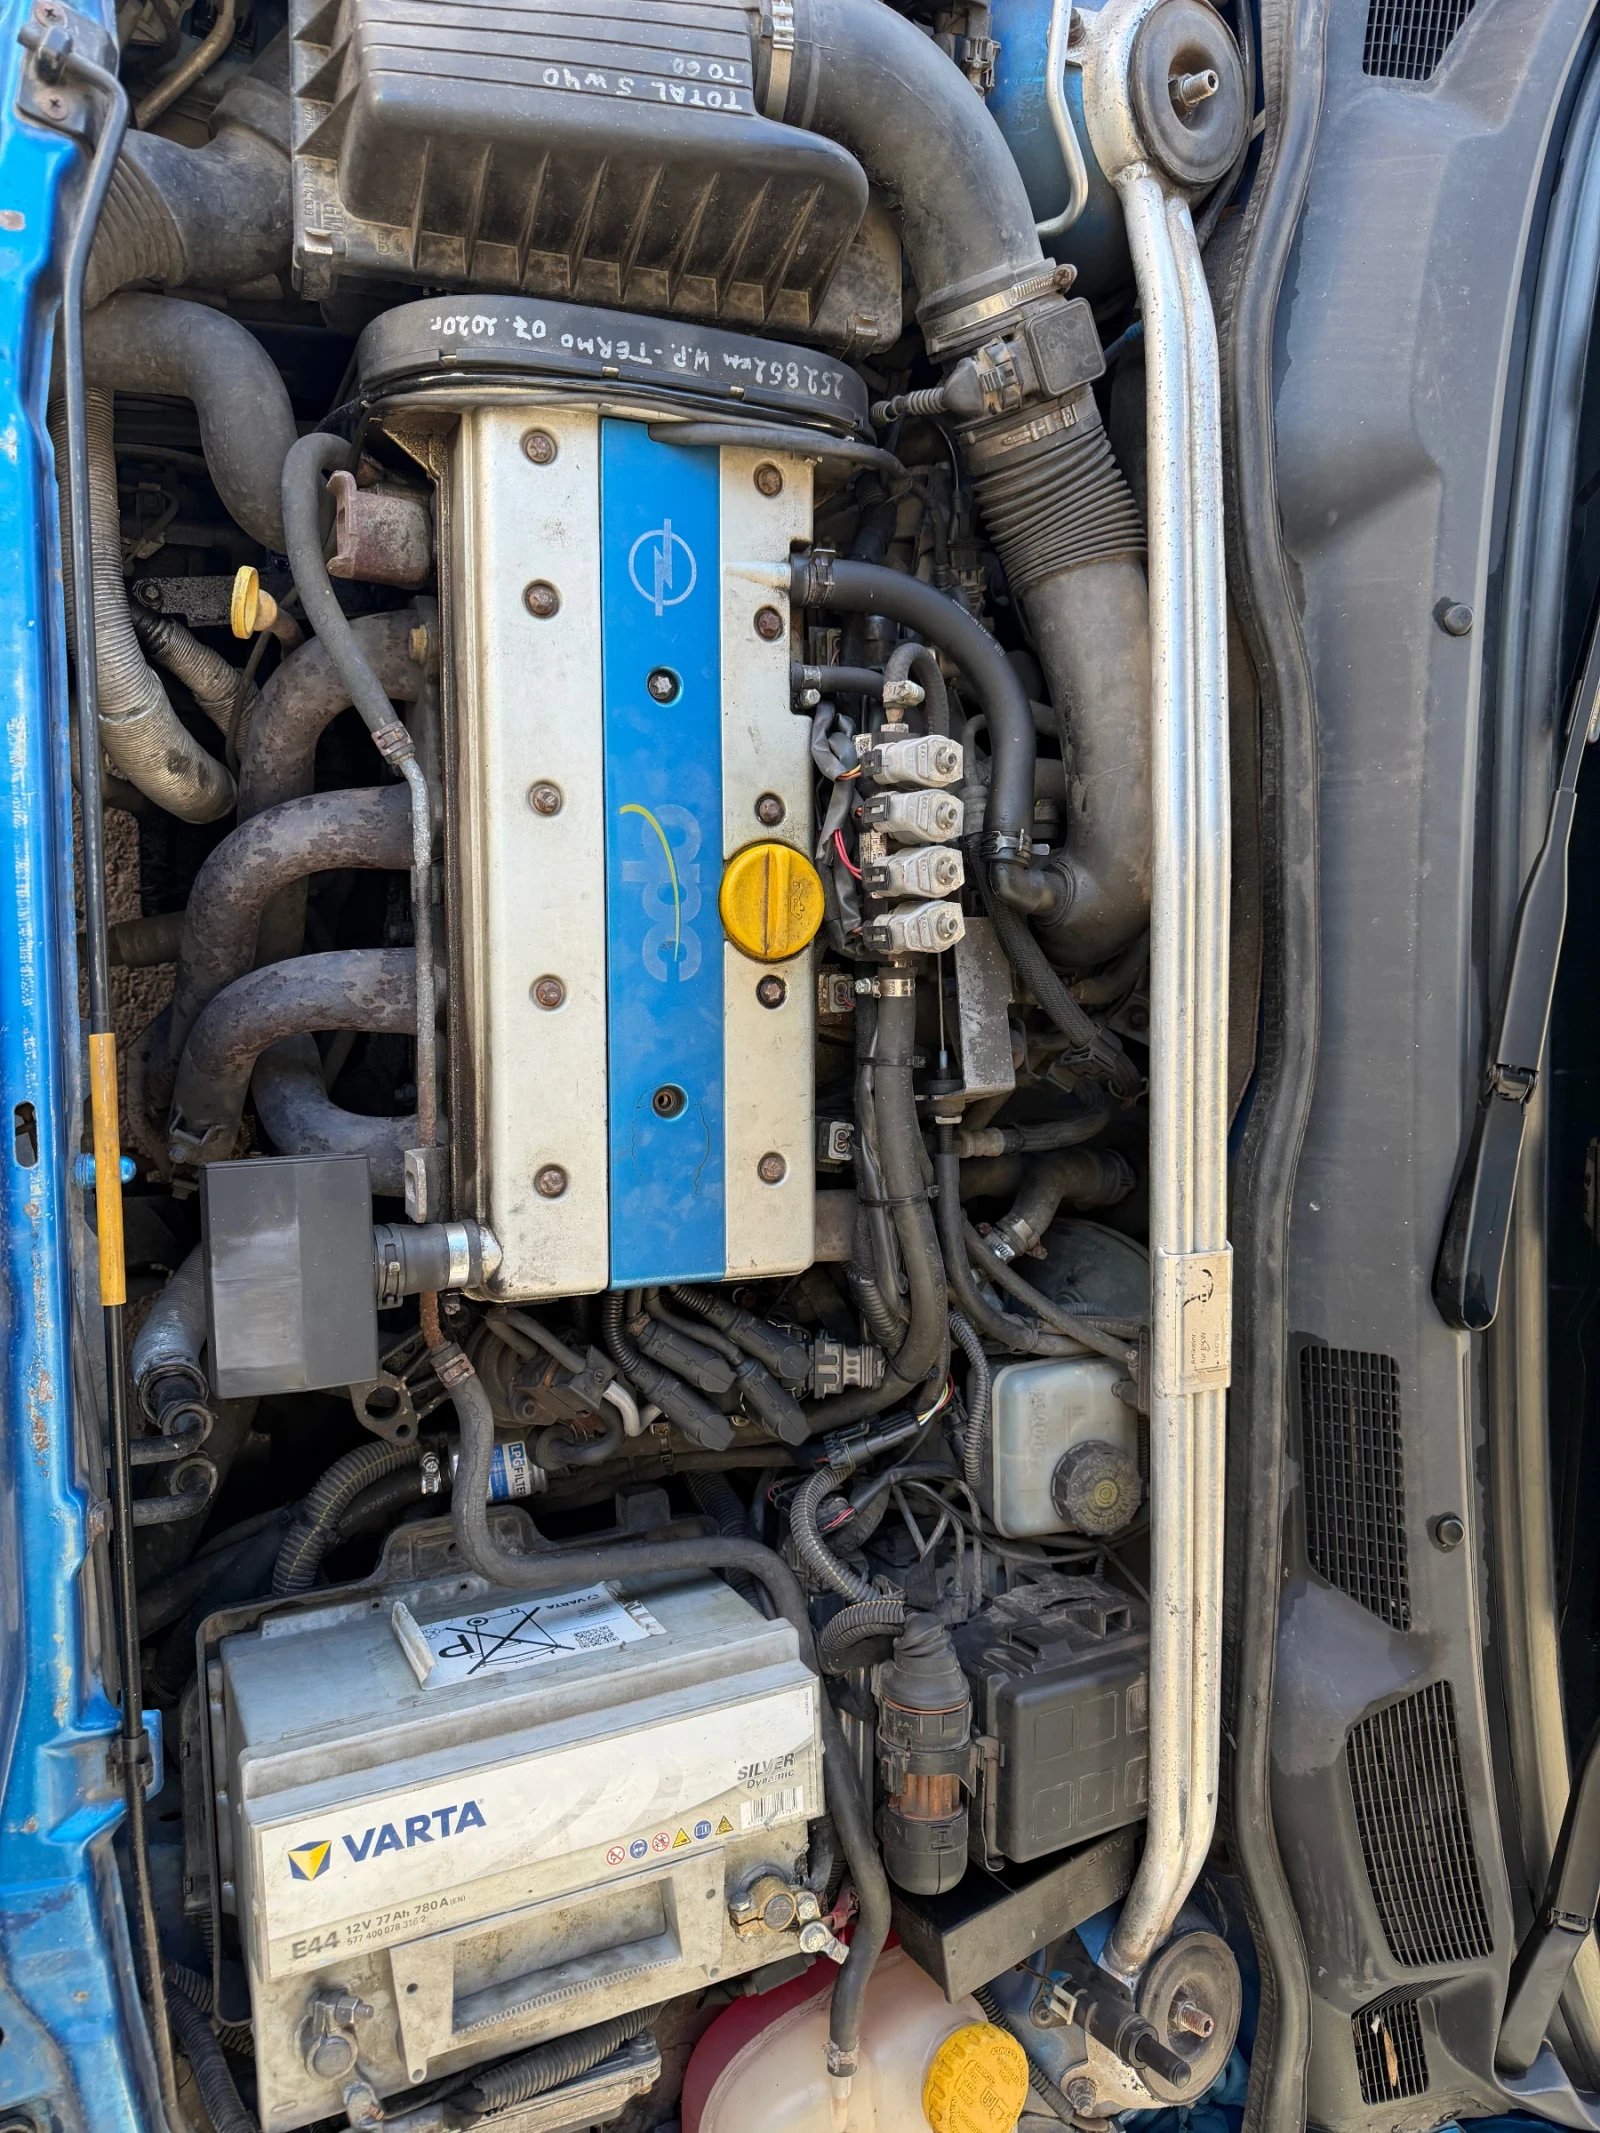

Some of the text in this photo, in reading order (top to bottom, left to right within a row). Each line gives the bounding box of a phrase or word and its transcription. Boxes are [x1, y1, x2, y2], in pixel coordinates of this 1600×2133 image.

[651, 81, 743, 110] TOTAL
[622, 804, 702, 983] opc
[510, 1444, 527, 1497] LPG FILTER
[545, 1596, 590, 1611] VARTA
[737, 1752, 795, 1781] SILVER
[746, 1769, 794, 1789] Dynamic
[341, 1799, 487, 1863] VARTA
[345, 1919, 372, 1936] 12V
[346, 1934, 364, 1946] 577
[365, 1929, 384, 1940] 400
[384, 1923, 401, 1935] 078
[291, 1930, 341, 1960] E44
